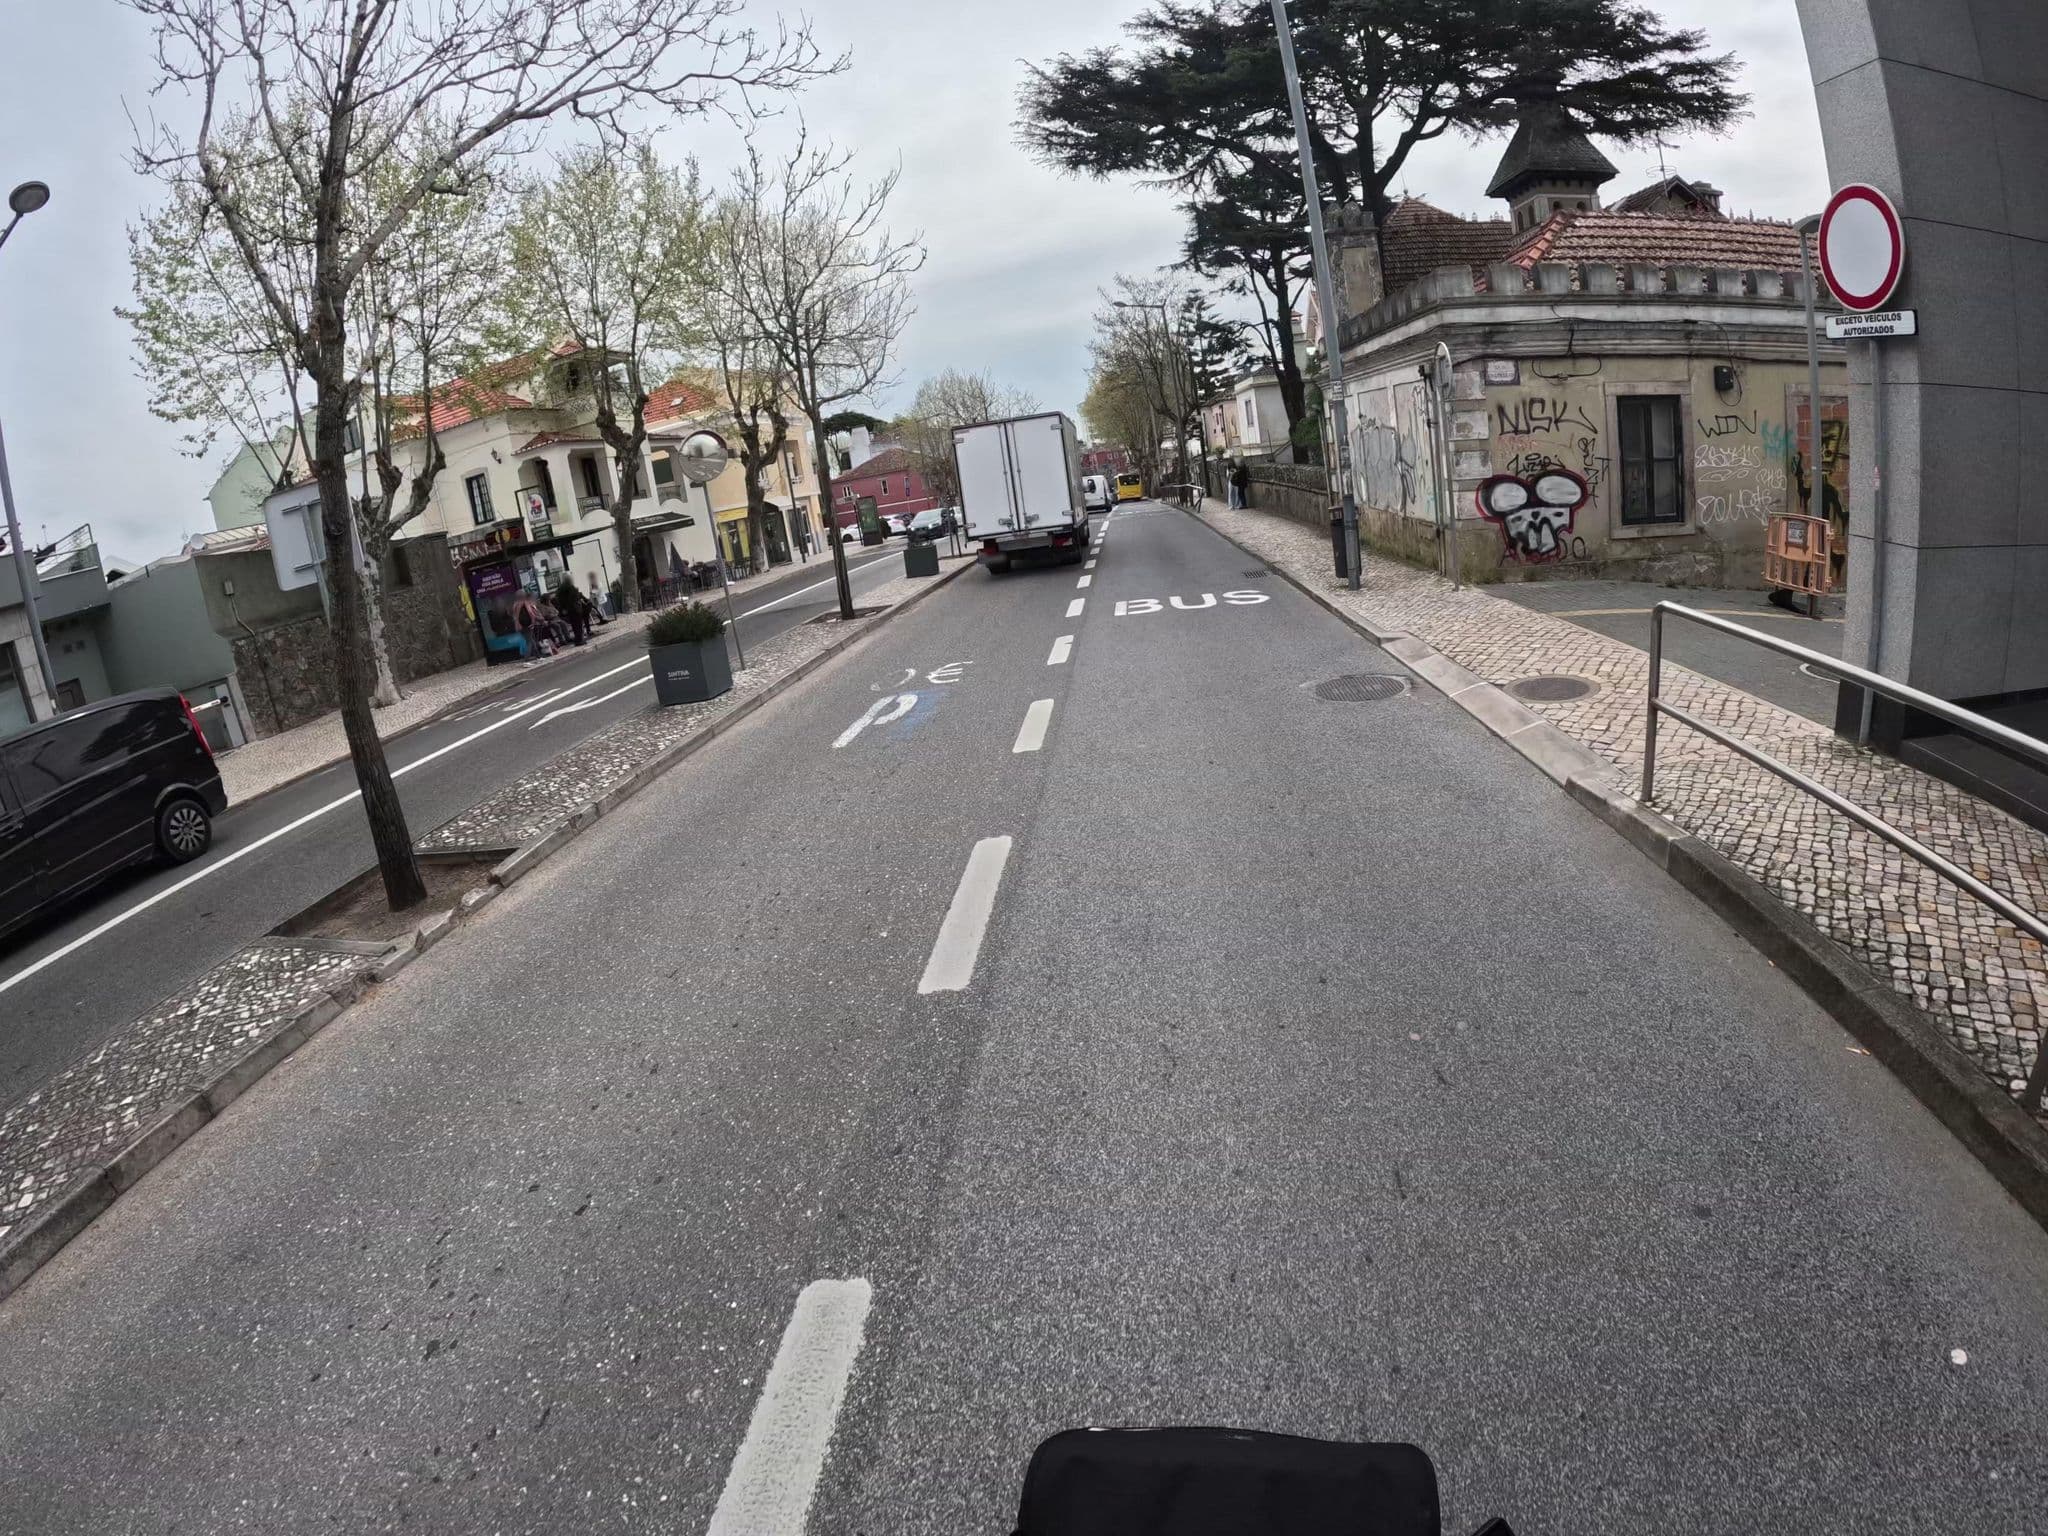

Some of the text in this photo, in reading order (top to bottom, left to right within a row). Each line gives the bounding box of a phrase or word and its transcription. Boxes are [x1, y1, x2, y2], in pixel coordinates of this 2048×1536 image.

[1835, 316, 1863, 326] EXCETO
[1843, 325, 1895, 336] AUTORIZADOS
[1114, 590, 1271, 616] BUS
